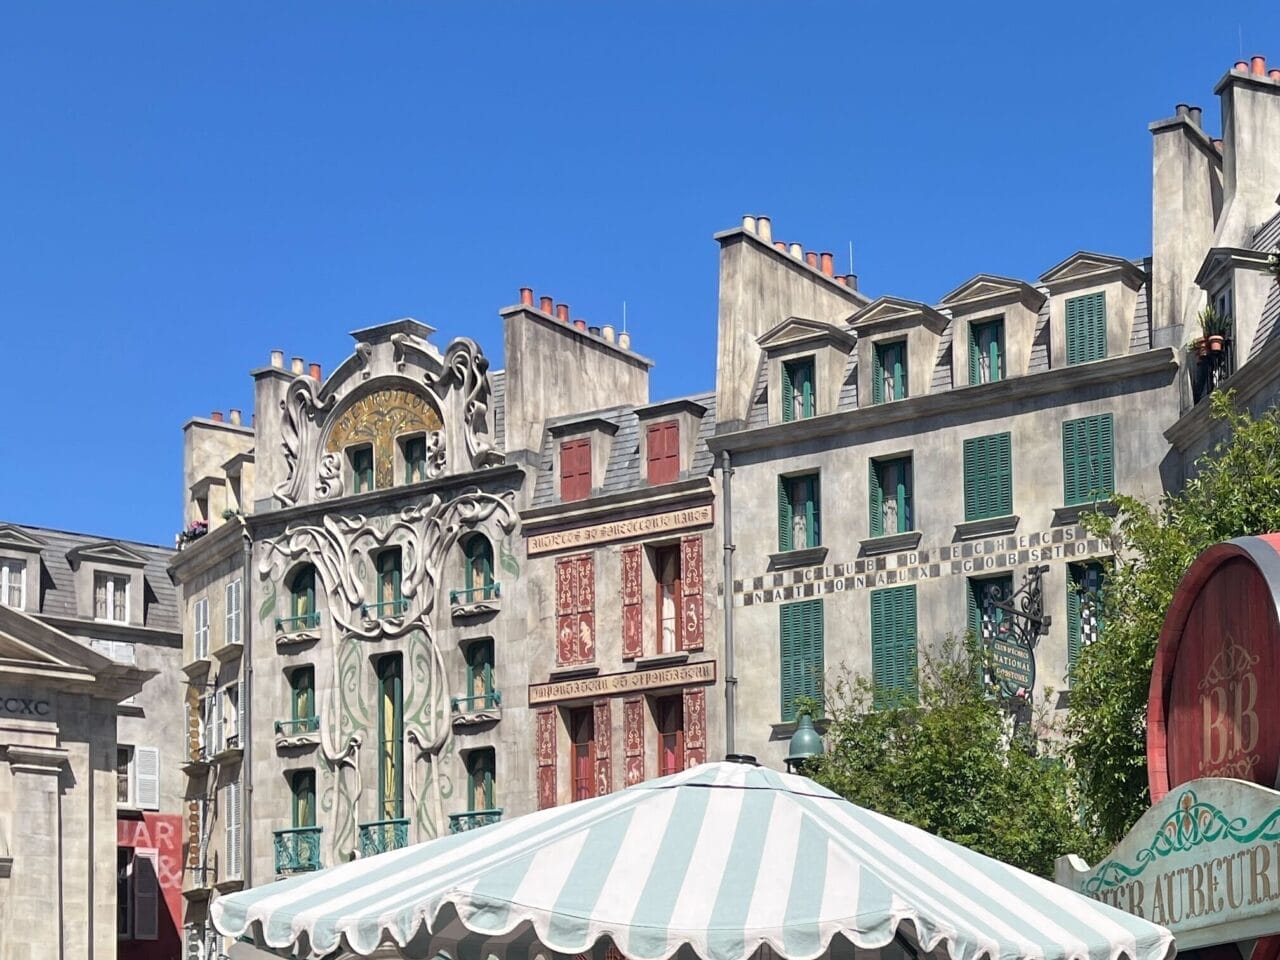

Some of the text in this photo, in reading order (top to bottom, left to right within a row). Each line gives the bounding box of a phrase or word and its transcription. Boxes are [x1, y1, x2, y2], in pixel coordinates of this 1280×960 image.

[803, 559, 875, 581] CLUB
[754, 567, 929, 602] NATIONAUX
[993, 652, 1031, 672] NATIONAL
[0, 697, 49, 715] CXC
[1198, 672, 1260, 771] BB
